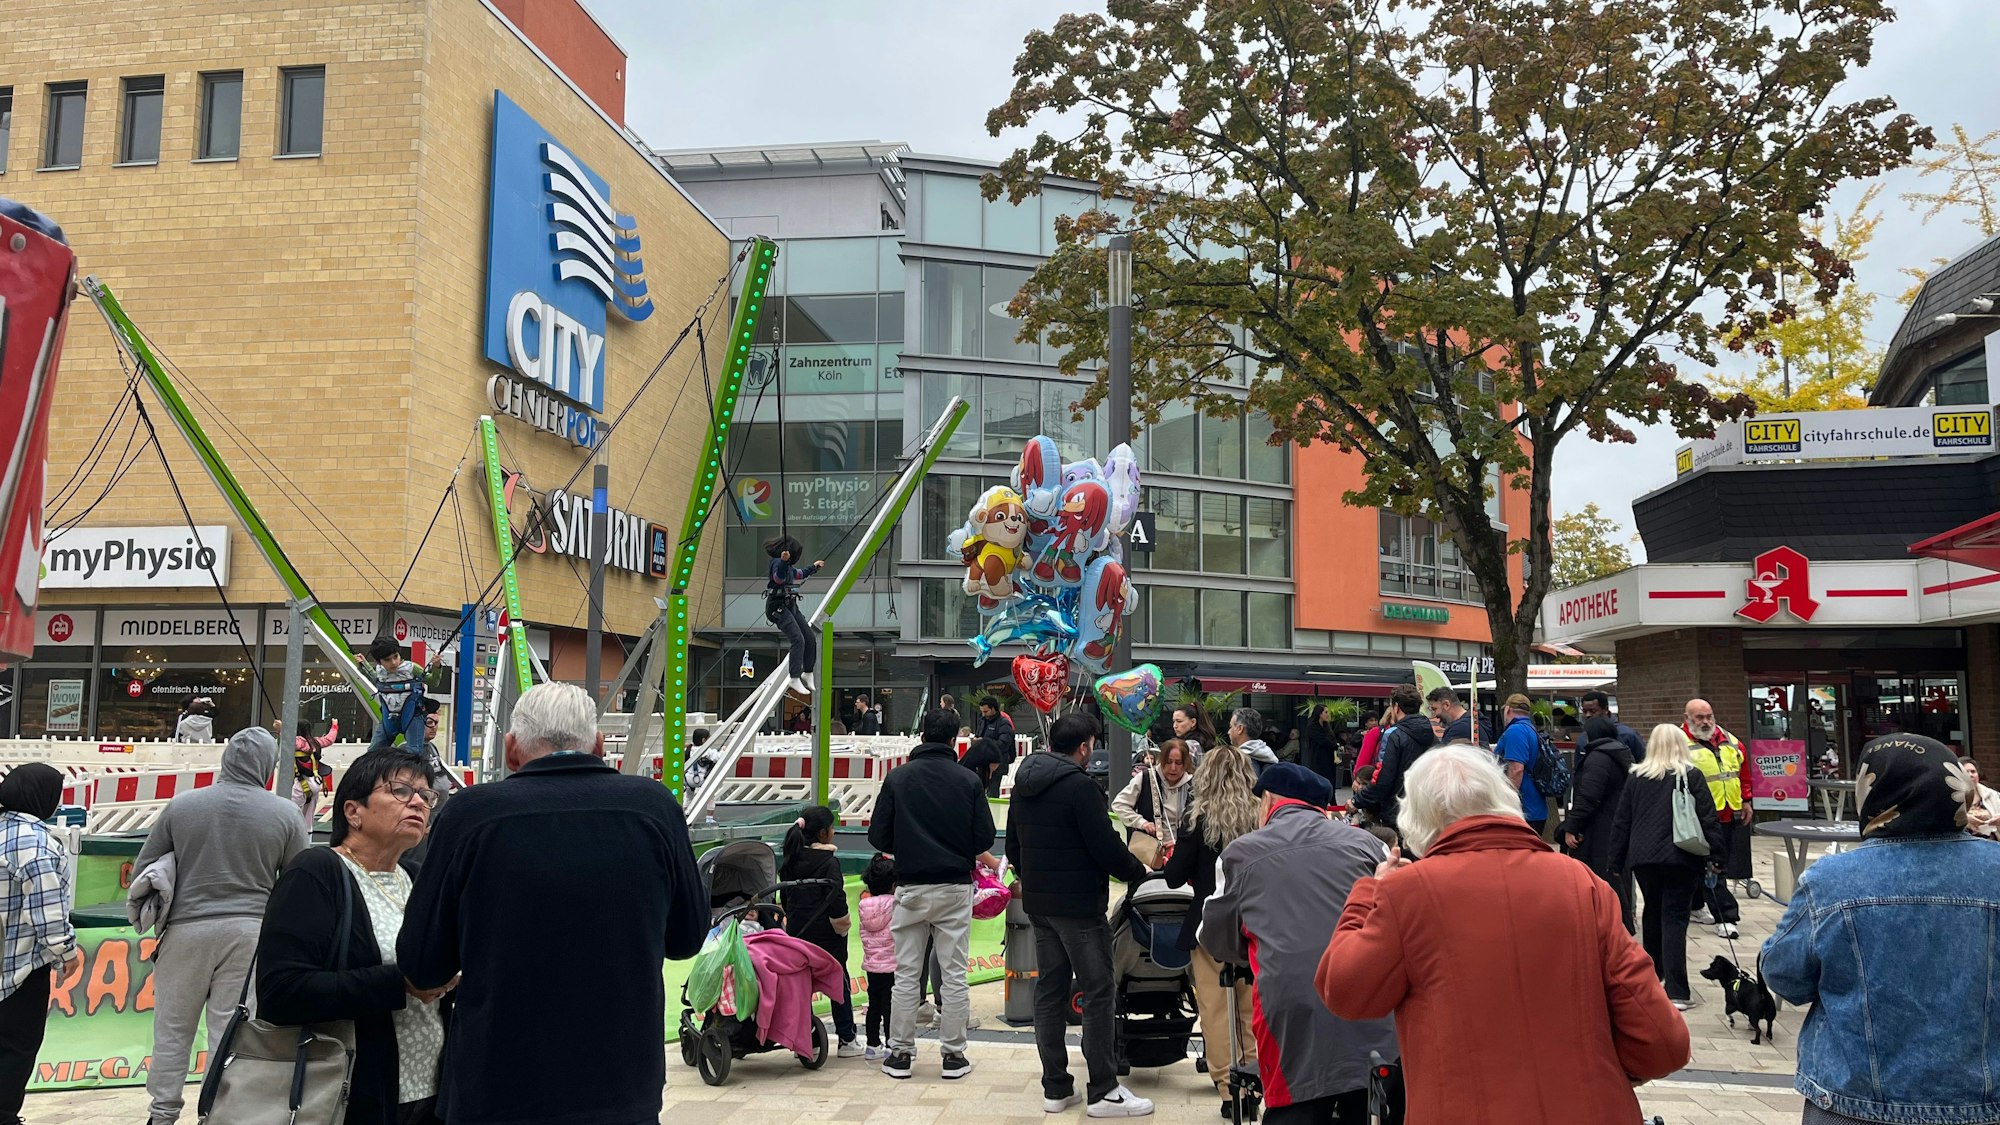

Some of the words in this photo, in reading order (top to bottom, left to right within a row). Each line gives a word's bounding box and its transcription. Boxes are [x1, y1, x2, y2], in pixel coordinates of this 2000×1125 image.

[506, 291, 604, 405] CITY
[789, 357, 872, 368] Zahnzentrum
[818, 371, 842, 381] Köln
[1748, 424, 1795, 441] CITY
[1804, 426, 1930, 444] cityfahrschule.de
[1937, 416, 1985, 433] CITY
[1937, 436, 1987, 445] FAHRSCHULE
[1749, 444, 1797, 452] FAHRSCHULE
[788, 477, 869, 495] myPhysio
[803, 499, 815, 509] 3.
[818, 498, 855, 511] Etage
[50, 538, 217, 580] myPhysio
[1384, 604, 1450, 623] DEICHMANN
[1559, 588, 1618, 626] APOTHEKE
[121, 620, 240, 635] MIDDELBERG
[1440, 661, 1450, 671] Eis
[1755, 755, 1800, 765] GRIPPE?
